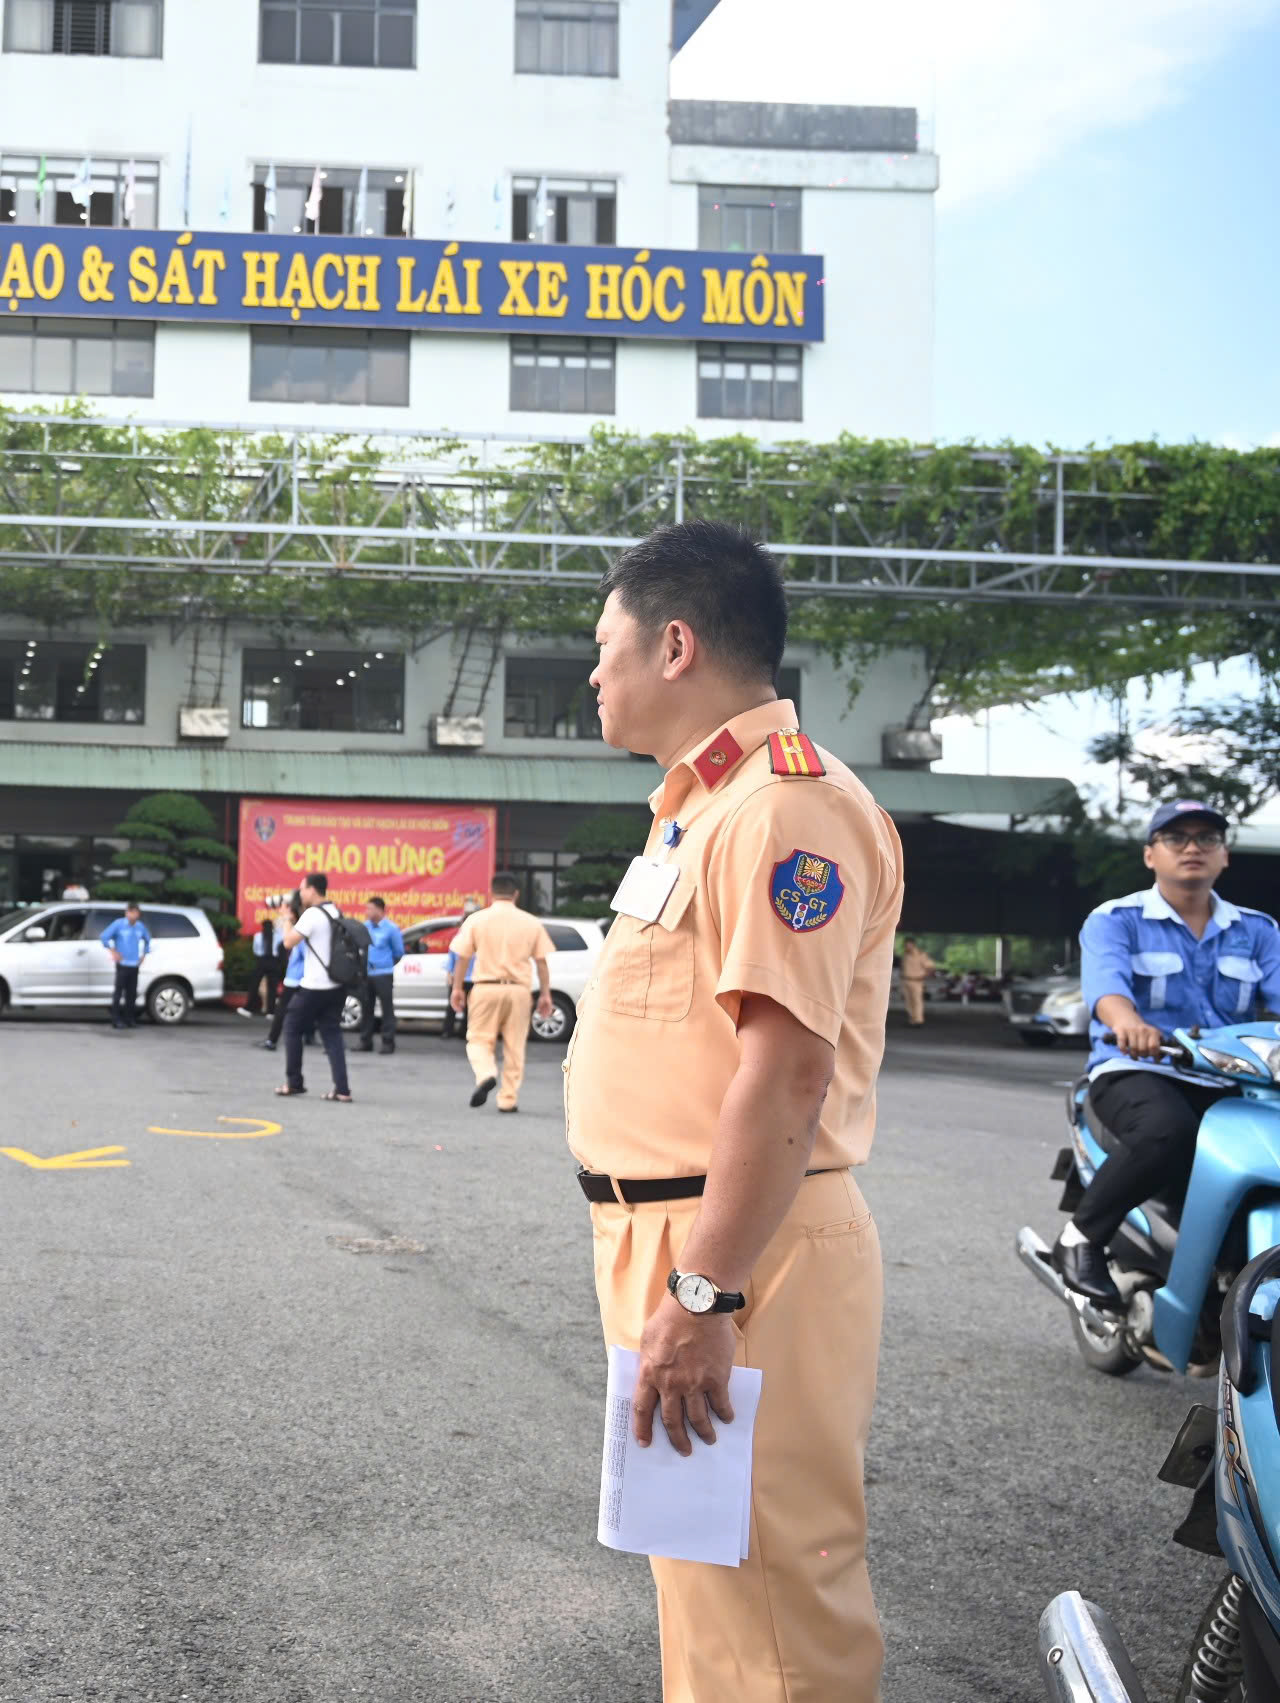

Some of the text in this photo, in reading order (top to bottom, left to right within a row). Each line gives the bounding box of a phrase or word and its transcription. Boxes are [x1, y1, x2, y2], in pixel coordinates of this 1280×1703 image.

[79, 246, 114, 302] &
[129, 231, 226, 305] SÁT
[243, 251, 381, 321] HẠCH
[397, 242, 482, 315] LÁI
[499, 261, 569, 318] XE
[586, 250, 685, 323] HÓC
[703, 255, 807, 327] MÔN
[287, 836, 445, 876] CHÀO MỪNG
[780, 888, 828, 912] CS GT
